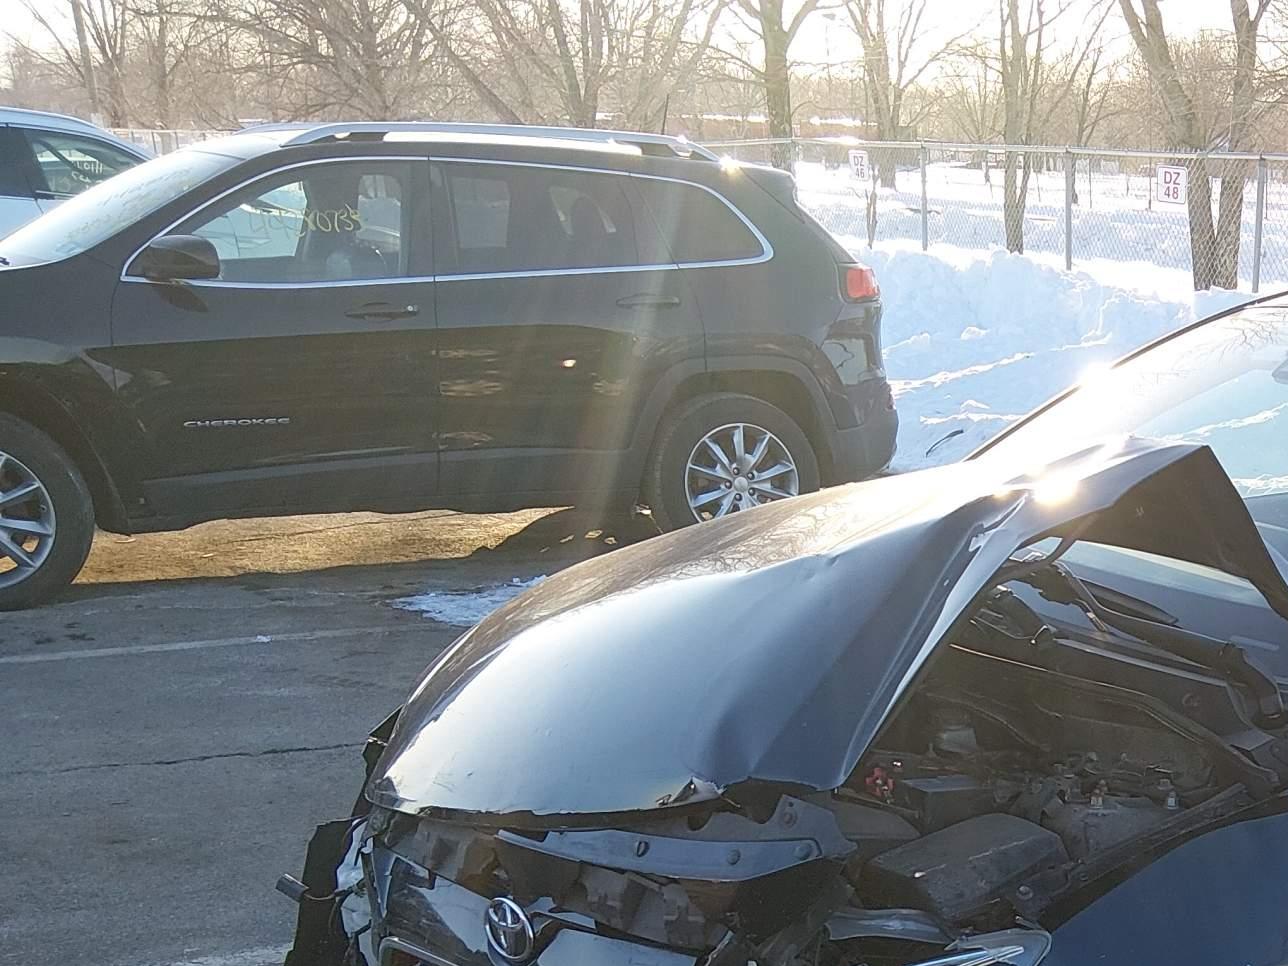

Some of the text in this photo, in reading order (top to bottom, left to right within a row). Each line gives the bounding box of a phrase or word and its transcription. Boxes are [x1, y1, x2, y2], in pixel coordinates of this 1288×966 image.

[853, 155, 865, 167] DZ
[1163, 170, 1181, 186] DZ
[1163, 186, 1179, 200] 48
[183, 417, 290, 428] CHEROKEE
